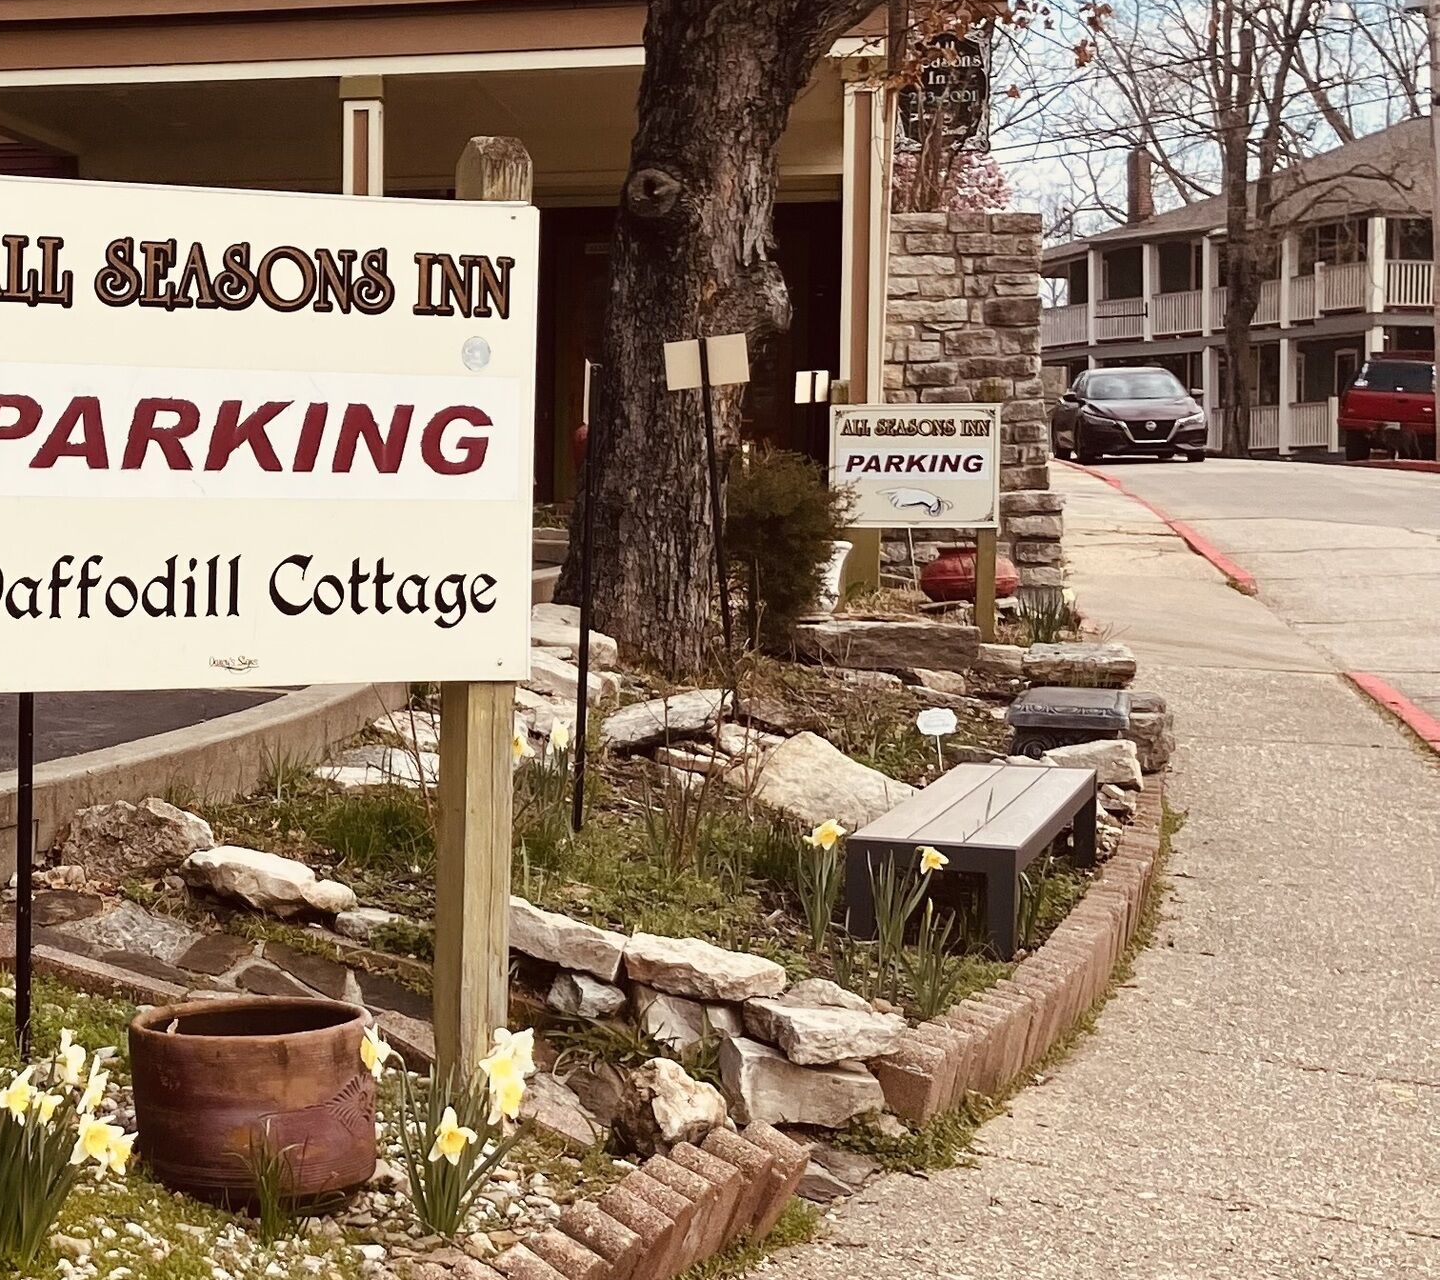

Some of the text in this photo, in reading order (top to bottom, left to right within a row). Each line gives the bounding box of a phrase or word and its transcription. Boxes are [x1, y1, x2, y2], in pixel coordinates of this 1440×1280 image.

[93, 236, 395, 316] SEASONS
[413, 252, 516, 320] INN
[840, 419, 991, 437] ALL SEASONS INN
[845, 454, 984, 473] PARKING
[268, 554, 498, 629] Cottage
